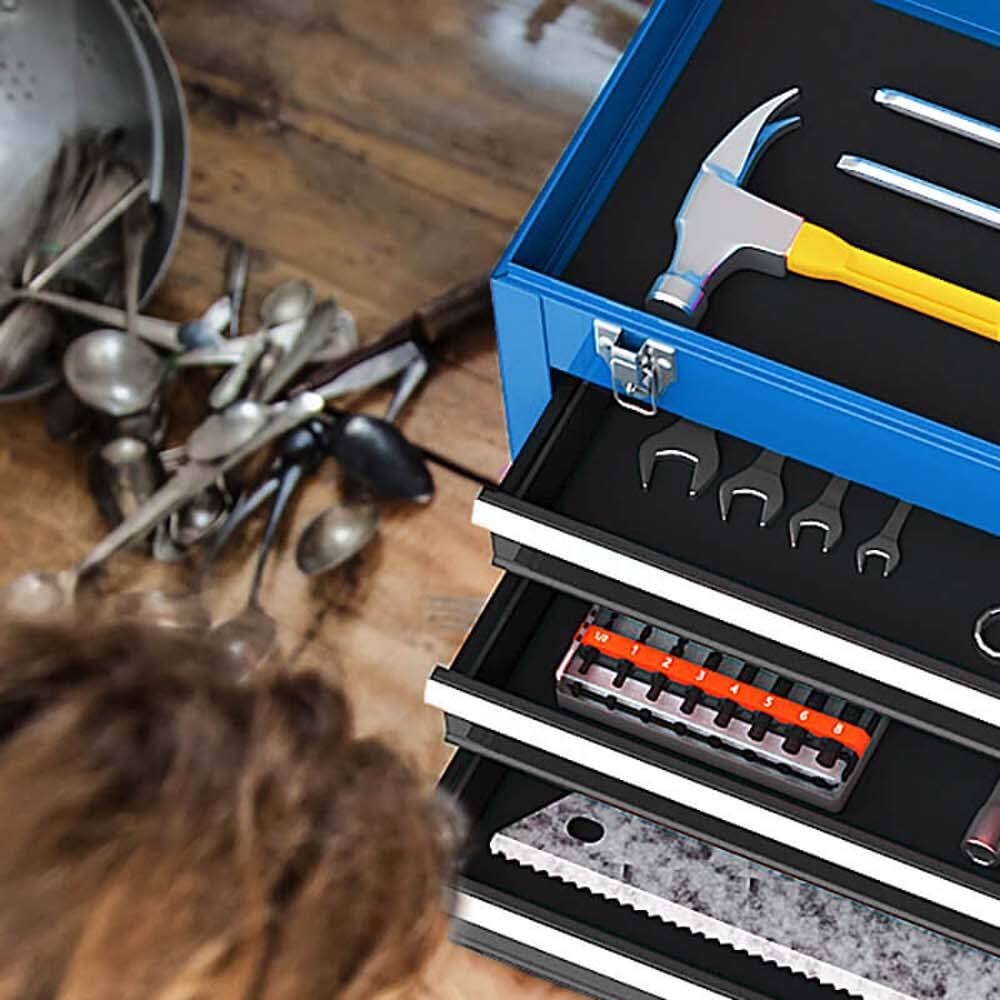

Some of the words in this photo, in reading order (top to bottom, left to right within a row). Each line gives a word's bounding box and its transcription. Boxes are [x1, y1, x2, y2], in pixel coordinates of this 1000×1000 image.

[631, 645, 639, 655] 1
[661, 657, 672, 669] 2
[695, 670, 706, 681] 3
[729, 683, 739, 694] 4
[763, 696, 774, 708] 5
[799, 710, 809, 721] 6
[833, 722, 844, 735] 8
